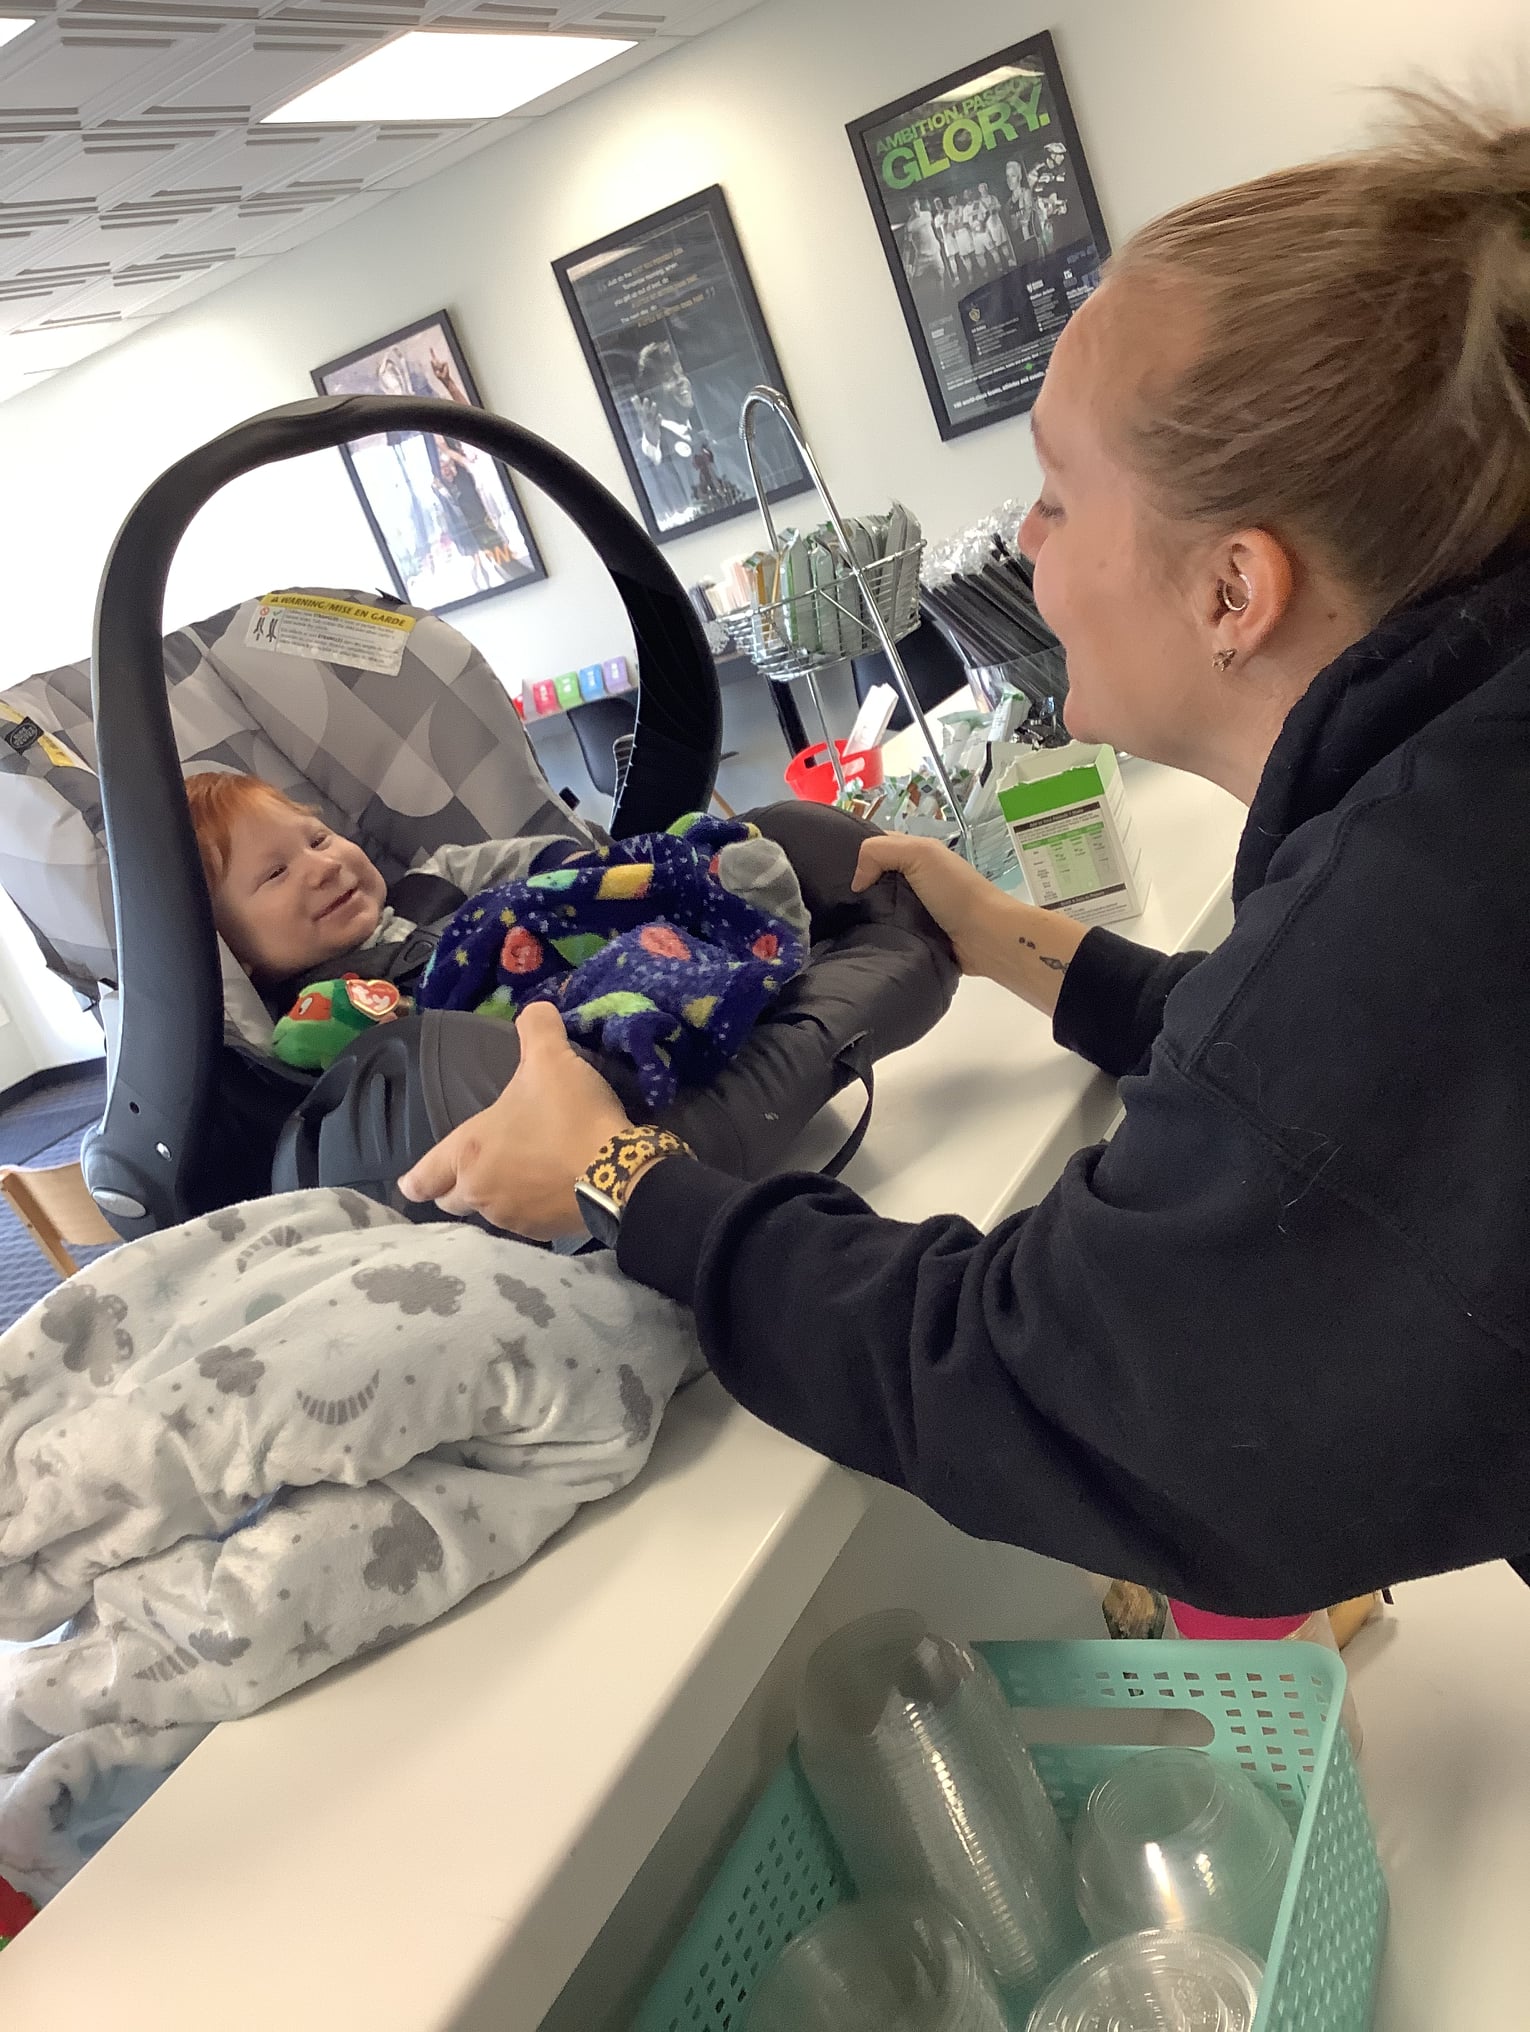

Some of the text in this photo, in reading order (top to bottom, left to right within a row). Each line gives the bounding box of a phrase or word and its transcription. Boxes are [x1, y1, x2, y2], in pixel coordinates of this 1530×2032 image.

[882, 82, 1051, 190] GLORY.
[354, 608, 368, 618] EN
[370, 612, 405, 627] GARDE
